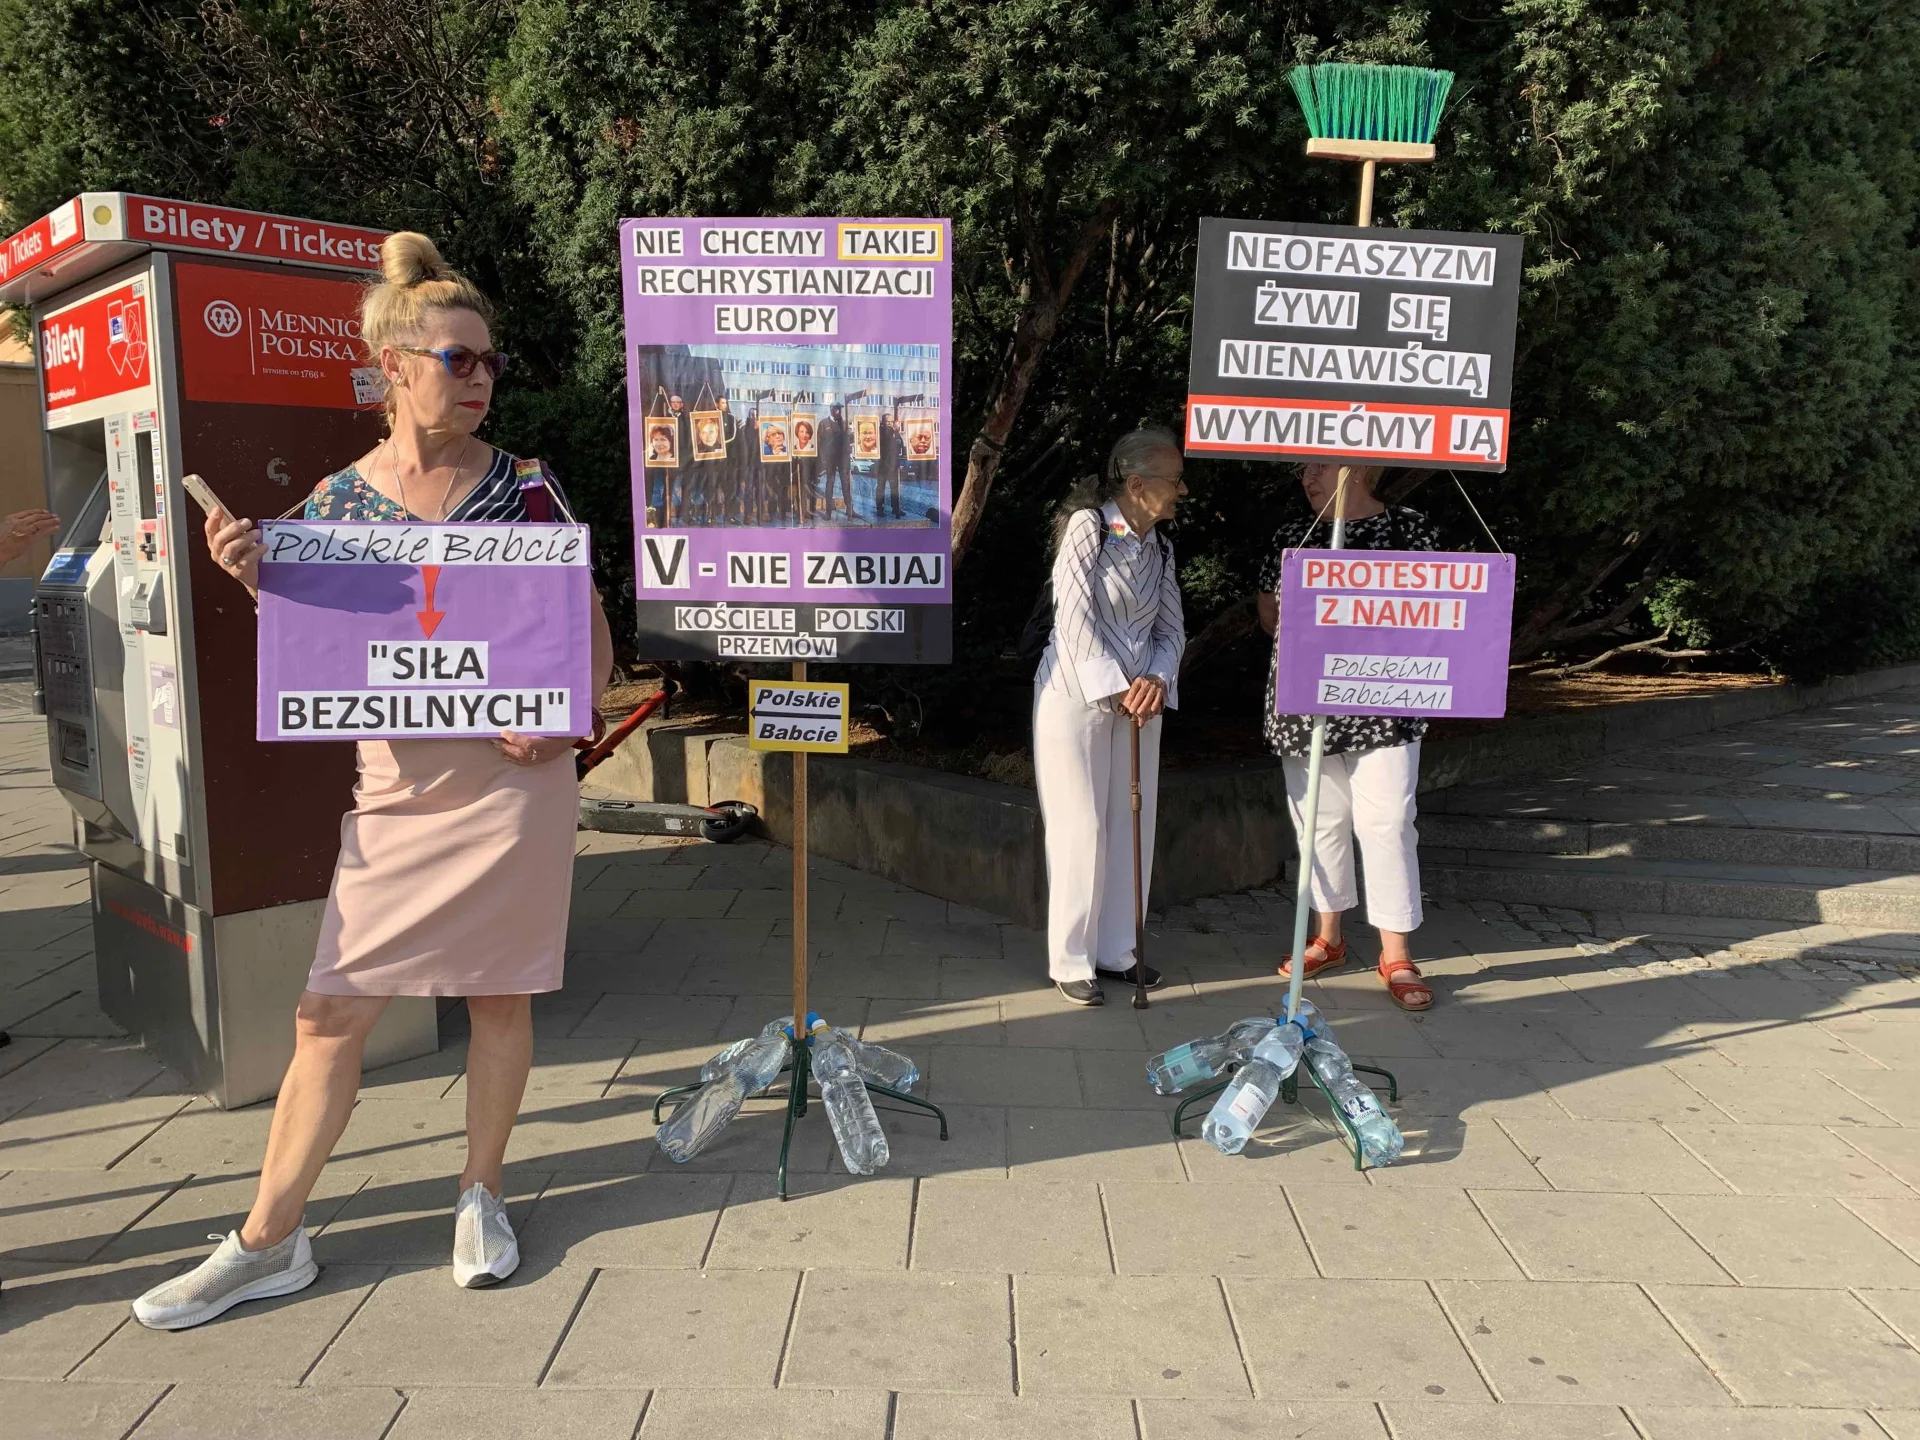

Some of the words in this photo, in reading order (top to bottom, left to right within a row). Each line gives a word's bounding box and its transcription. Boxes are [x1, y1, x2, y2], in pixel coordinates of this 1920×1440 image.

[12, 231, 42, 265] Tickets
[143, 205, 246, 251] Bilety
[273, 223, 380, 263] Tickets
[635, 230, 681, 255] NIE
[702, 229, 824, 255] CHCEMY
[844, 229, 937, 255] TAKIEJ
[1231, 234, 1493, 283] NEOFASZYZM
[640, 267, 932, 296] RECHRYSTIANIZACJI
[258, 308, 361, 339] MENNIC
[716, 306, 836, 333] EUROPY
[1257, 280, 1356, 327] ŻYWI
[1391, 296, 1447, 340] SIĘ
[43, 323, 84, 372] Bilety
[259, 333, 357, 361] POLSKA
[300, 369, 319, 378] 1766
[1222, 342, 1483, 396] NIENAWIŚCIĄ
[1194, 404, 1433, 451] WYMIEĆMY
[1453, 417, 1498, 461] JĄ
[271, 527, 430, 563] Polskie
[442, 526, 580, 563] Babcie
[645, 538, 686, 586] V
[730, 555, 788, 585] NIE
[806, 555, 942, 585] ZABIJAJ
[1306, 560, 1484, 592] PROTESTUJ
[677, 603, 794, 631] KOŚCIELE
[816, 608, 903, 632] POLSKI
[1320, 598, 1339, 625] Z
[1352, 599, 1440, 628] NAMI
[719, 633, 834, 656] PRZEMÓW
[370, 643, 485, 681] "SIŁA
[281, 690, 565, 730] BEZSILNYCH"
[756, 688, 841, 709] Polskie
[758, 722, 838, 743] Babcie
